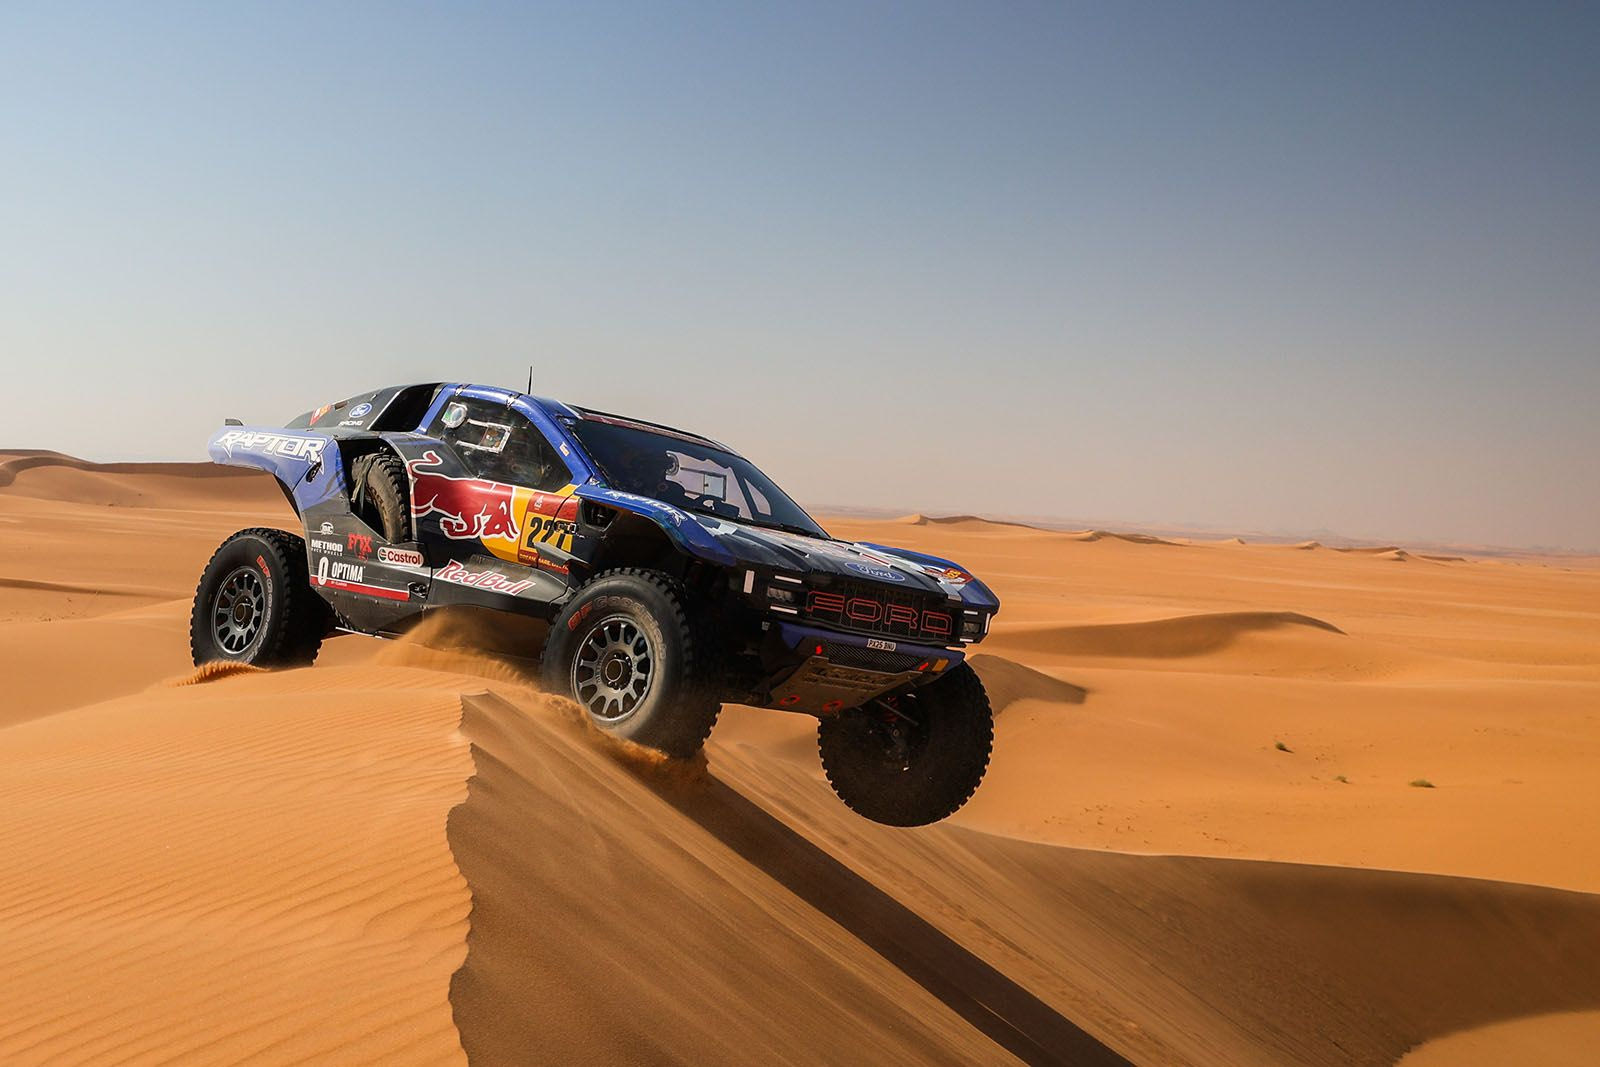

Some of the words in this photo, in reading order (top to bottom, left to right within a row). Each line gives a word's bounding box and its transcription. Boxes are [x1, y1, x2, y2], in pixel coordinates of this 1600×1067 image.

[214, 431, 326, 474] RAPTOR
[311, 539, 343, 552] METHOD
[387, 551, 421, 565] Castrol
[331, 561, 364, 583] OPTIMA
[805, 591, 953, 635] FORD
